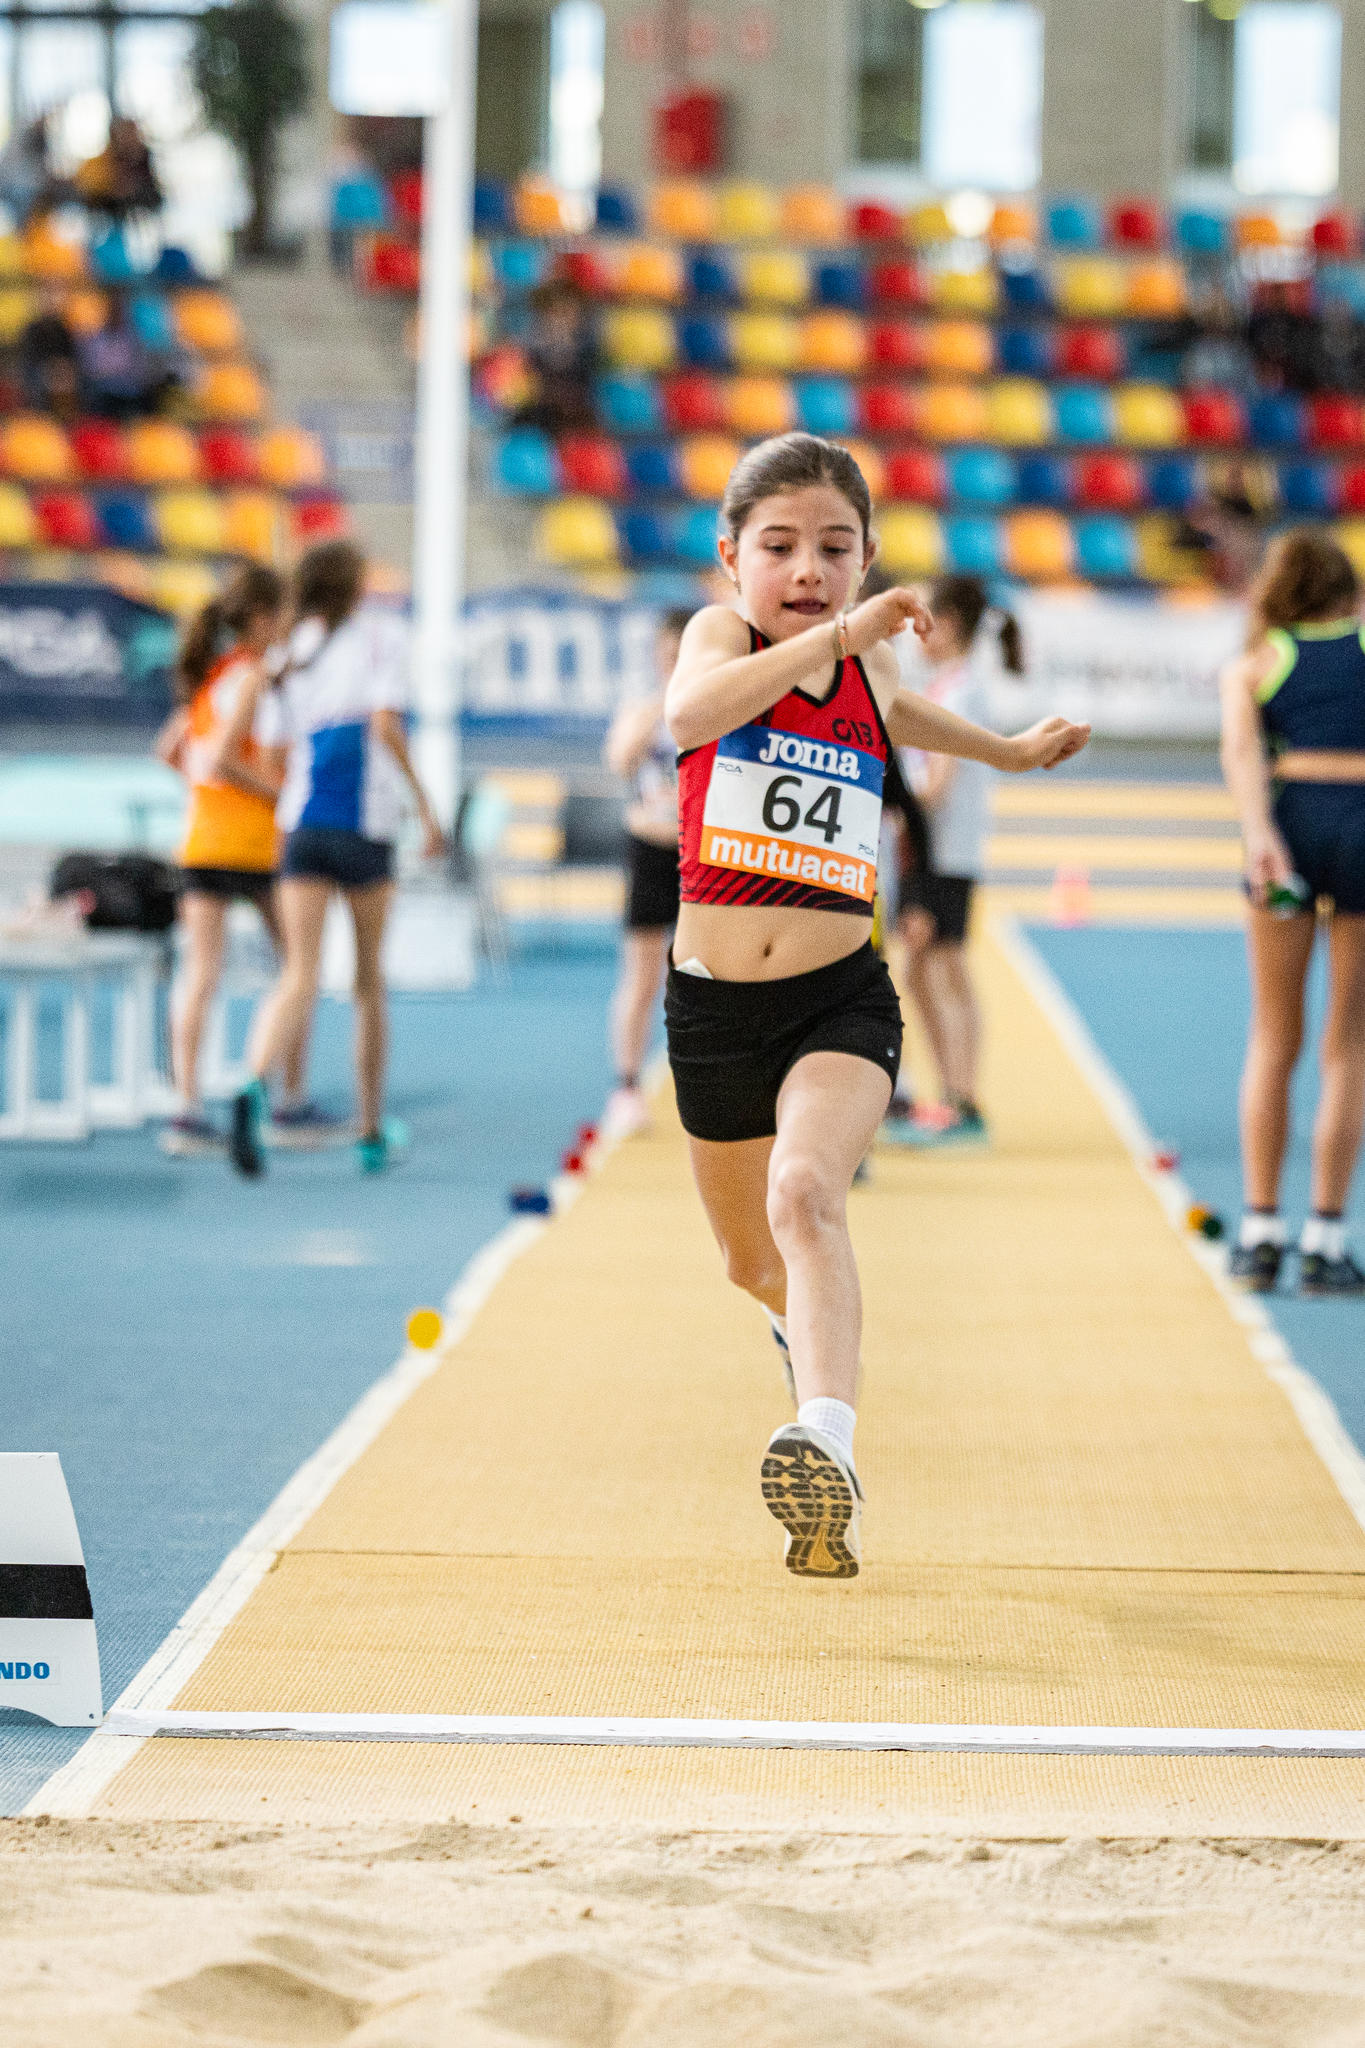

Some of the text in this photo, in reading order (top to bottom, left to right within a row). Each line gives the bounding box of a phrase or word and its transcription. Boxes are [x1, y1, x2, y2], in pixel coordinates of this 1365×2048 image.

[759, 732, 860, 780] Joma
[762, 775, 842, 844] 64
[709, 834, 868, 895] mutuacat
